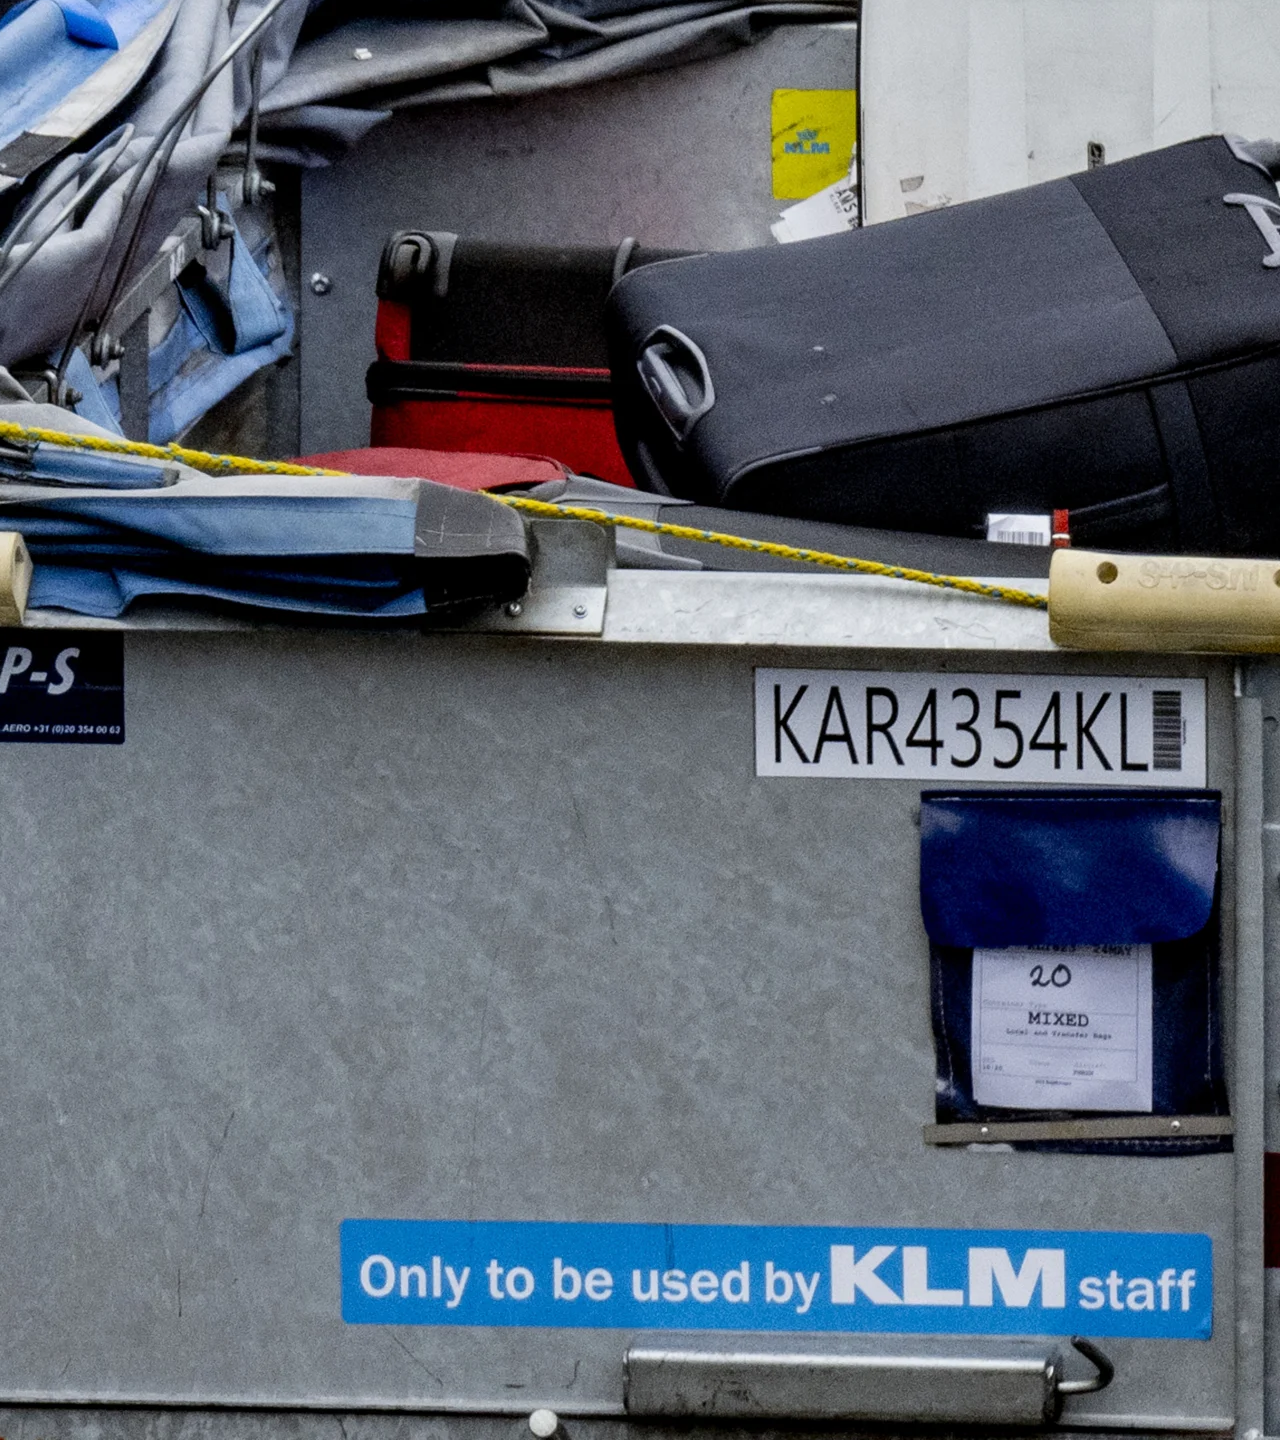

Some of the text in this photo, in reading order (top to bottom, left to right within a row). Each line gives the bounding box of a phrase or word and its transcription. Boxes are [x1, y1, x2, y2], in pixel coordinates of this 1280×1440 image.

[784, 141, 831, 154] KLM
[33, 724, 50, 733] +31
[51, 724, 76, 735] (0)20
[77, 725, 94, 734] 354
[109, 725, 121, 735] 63
[773, 683, 1149, 773] KAR4354KL
[1029, 963, 1072, 988] 20
[1027, 1011, 1090, 1028] MIXED
[359, 1244, 1197, 1314] Only to be used by KLM staff
